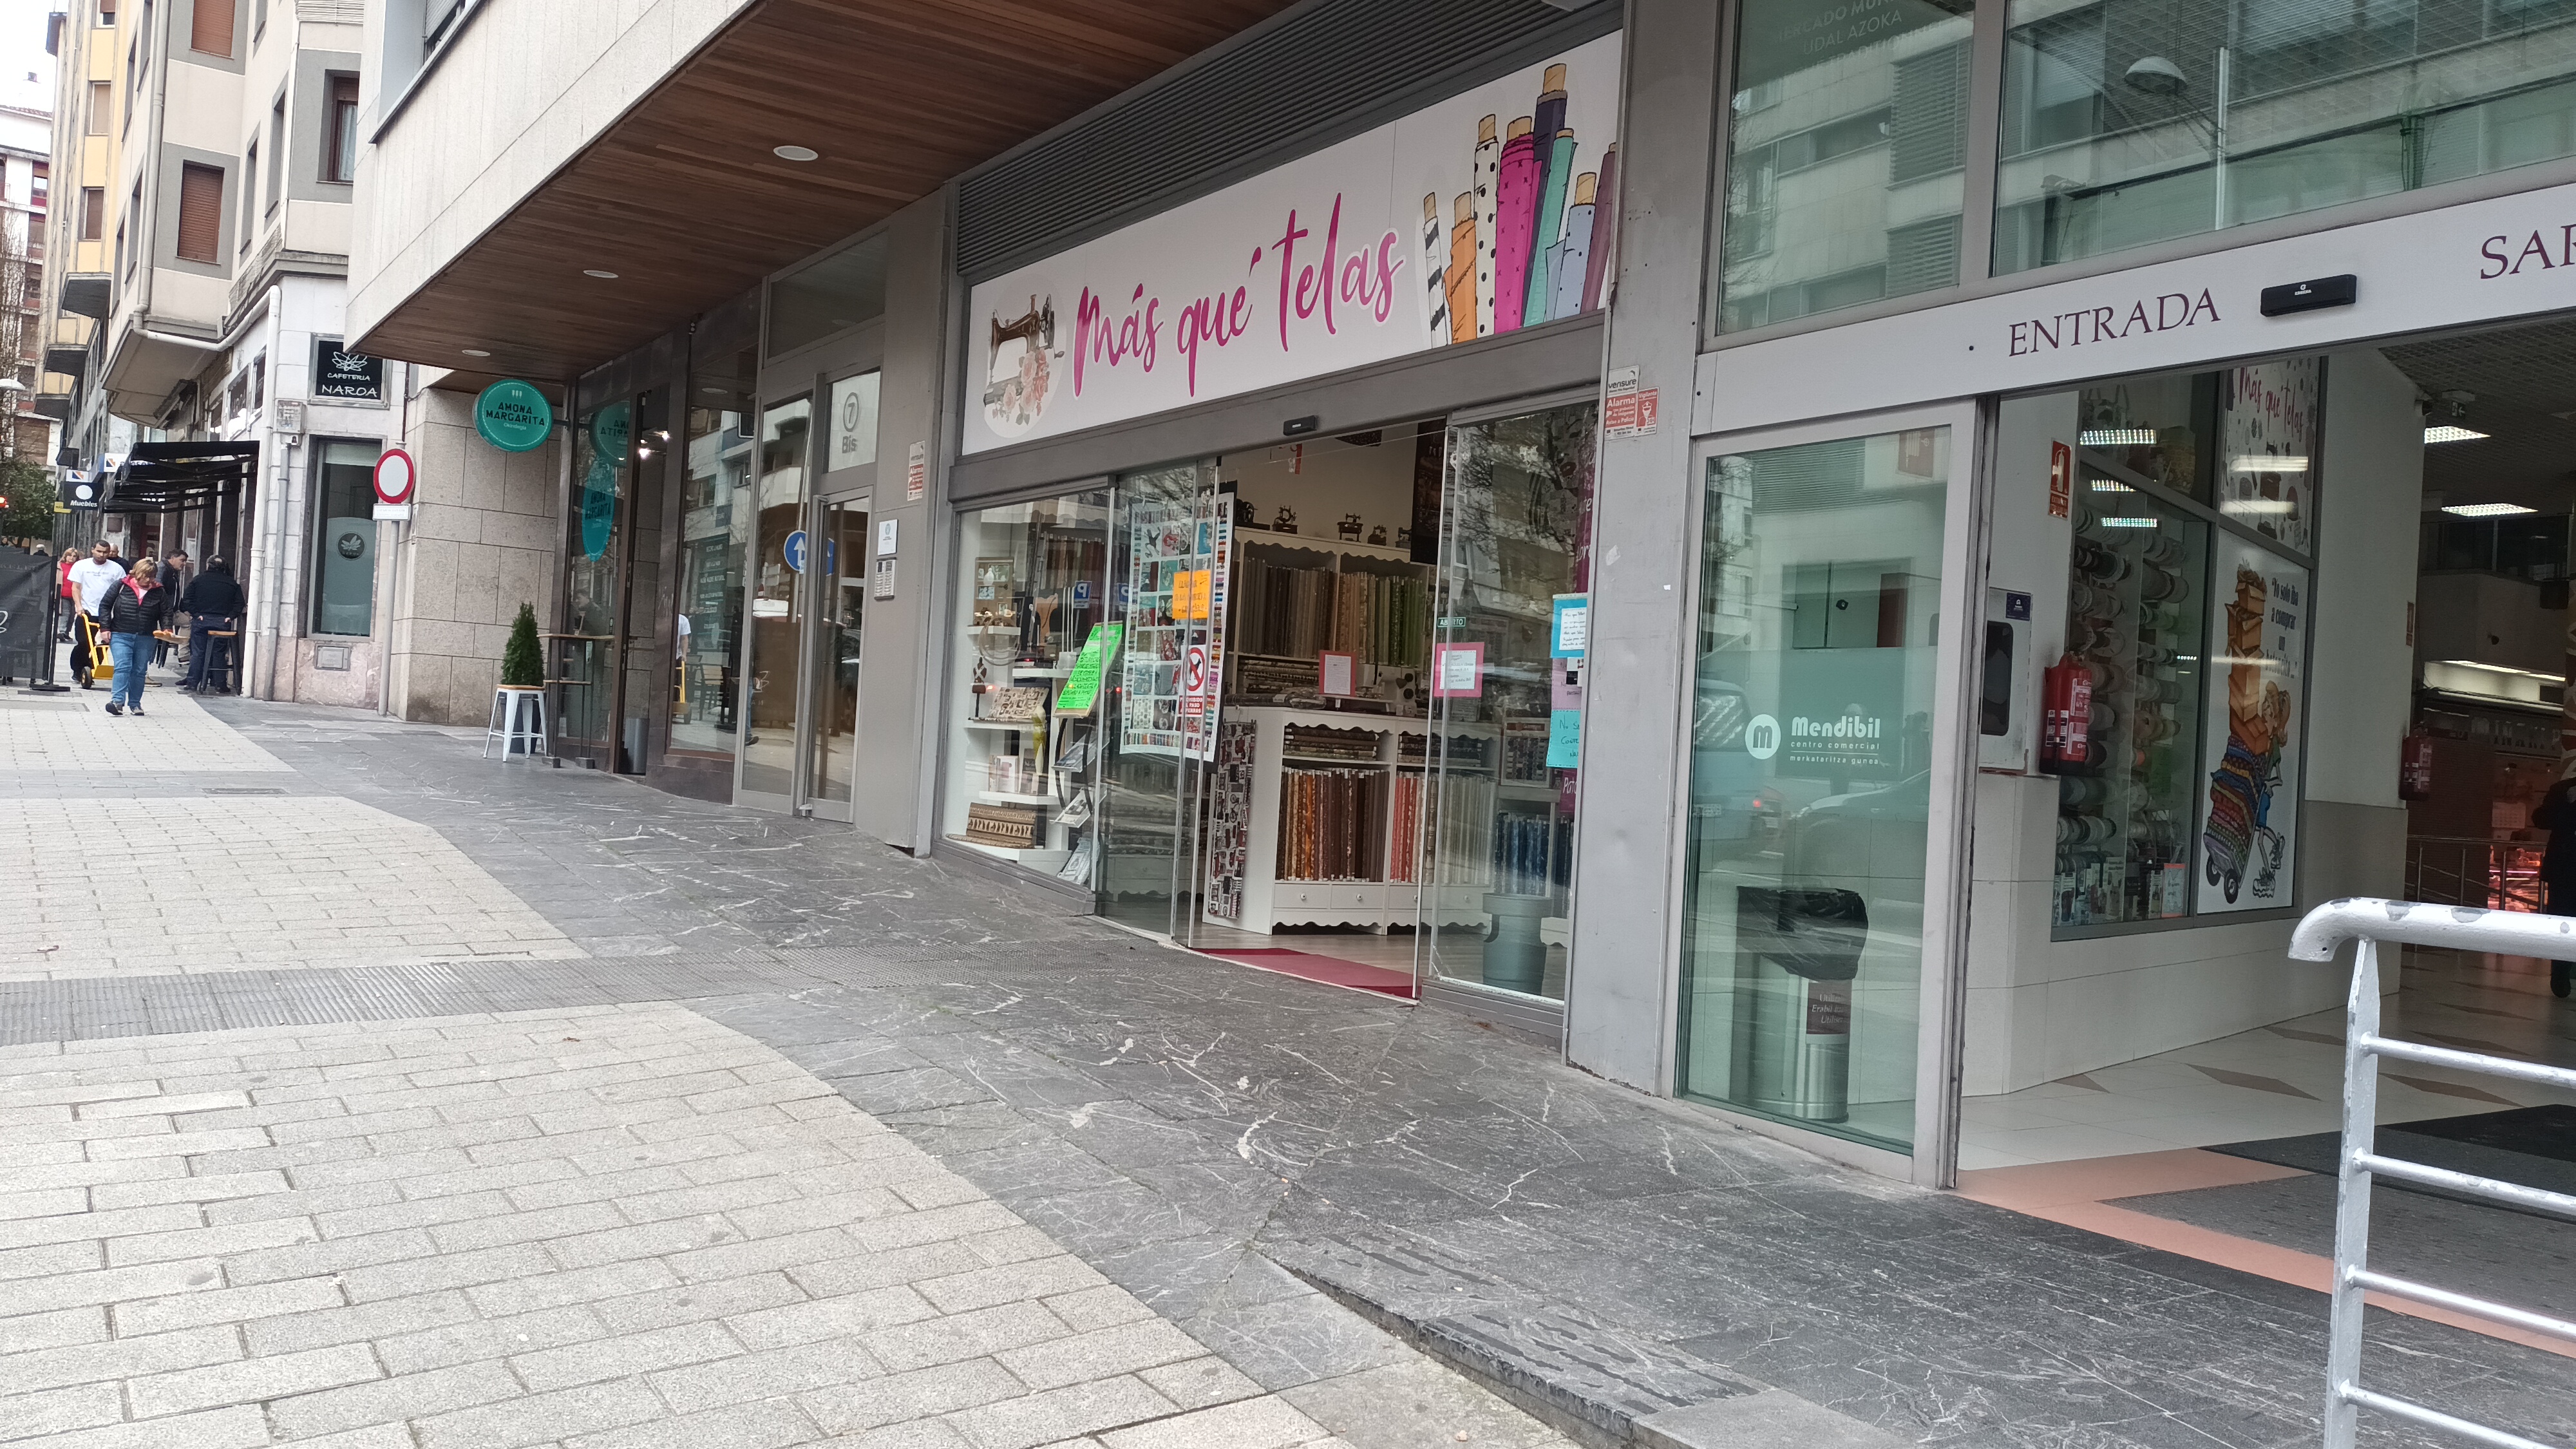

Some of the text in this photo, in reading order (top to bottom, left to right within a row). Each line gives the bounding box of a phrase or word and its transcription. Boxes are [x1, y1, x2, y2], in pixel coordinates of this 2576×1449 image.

[1847, 10, 1902, 41] AZOKA
[2009, 288, 2221, 357] ENTRADA
[322, 384, 377, 397] NAROA
[1608, 379, 1637, 389] verisure
[1638, 391, 1658, 399] Vigilante
[498, 402, 533, 415] AMONA
[1607, 397, 1636, 408] Alarma
[486, 410, 545, 426] MARGARITA
[848, 402, 855, 424] 7
[842, 435, 858, 453] Bis
[70, 499, 98, 508] Muebles
[1792, 715, 1880, 739] Mendibil
[1828, 742, 1880, 750] comercial
[1790, 755, 1846, 764] merkataritza
[1812, 1004, 1833, 1013] Erabil
